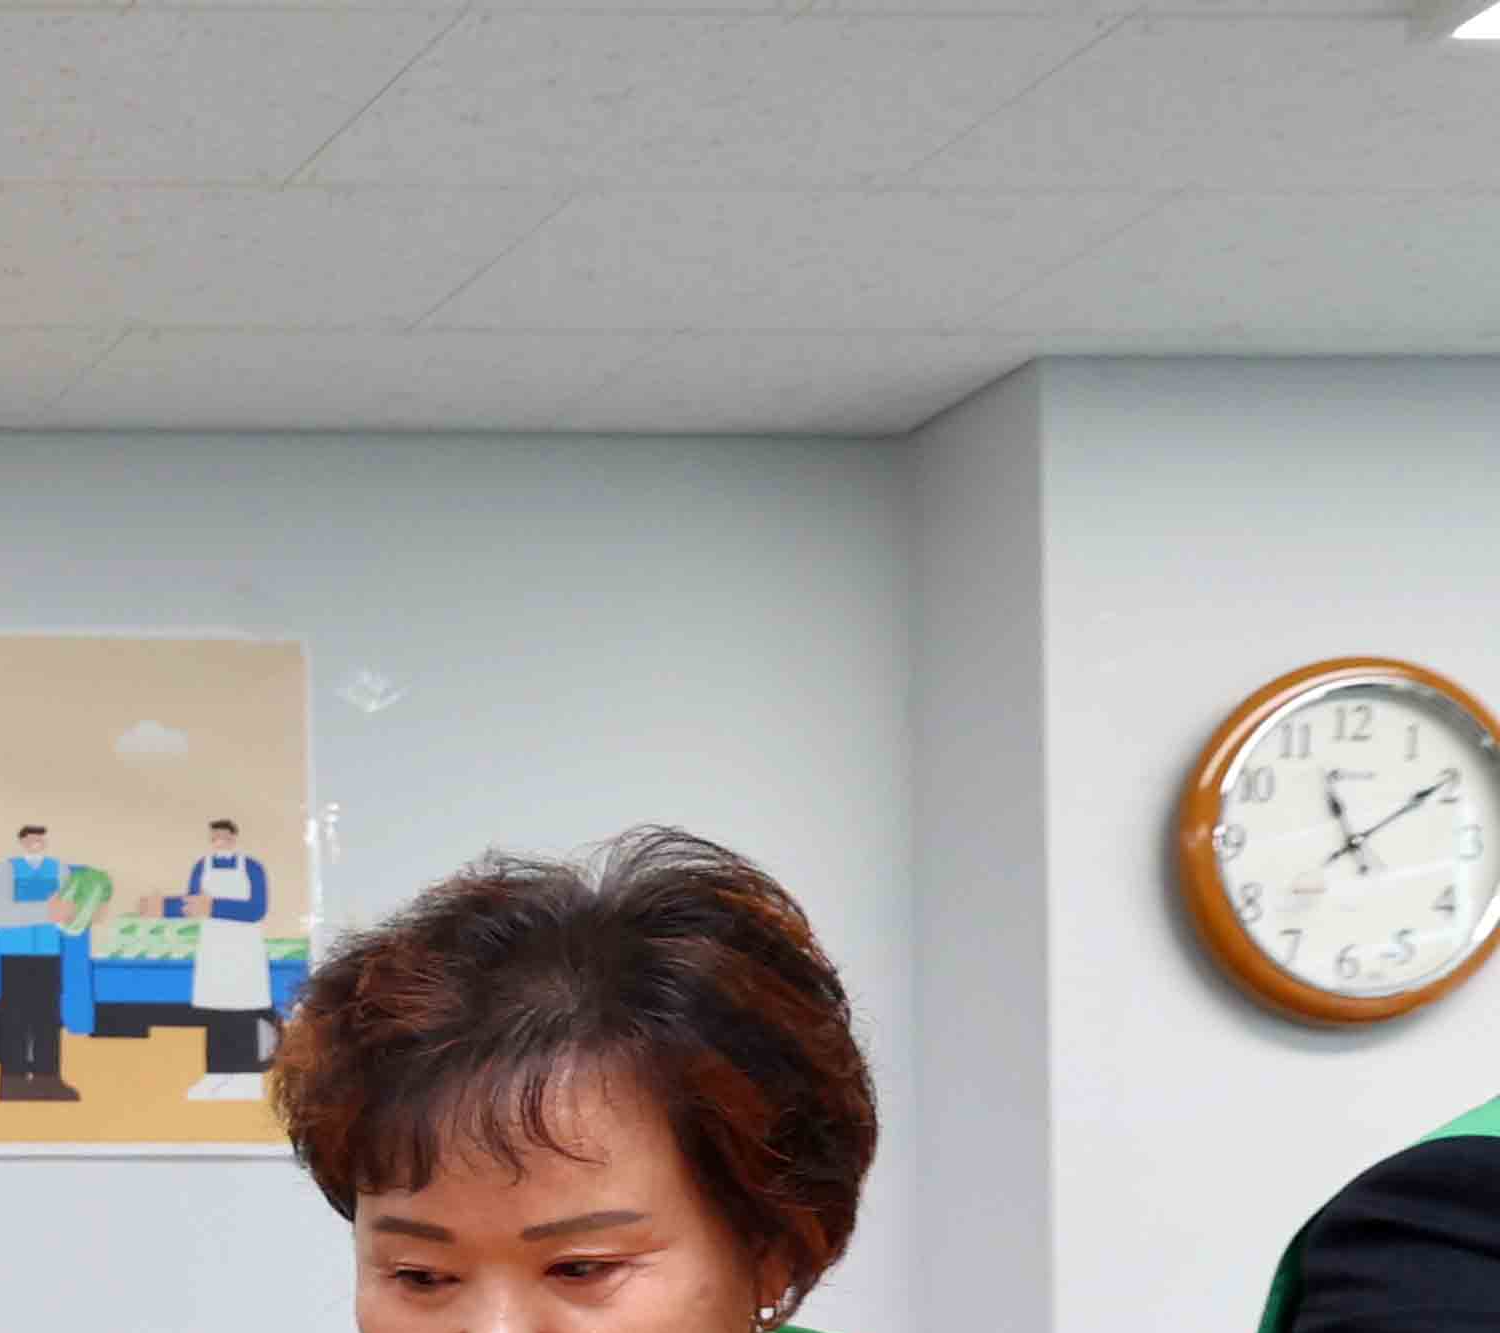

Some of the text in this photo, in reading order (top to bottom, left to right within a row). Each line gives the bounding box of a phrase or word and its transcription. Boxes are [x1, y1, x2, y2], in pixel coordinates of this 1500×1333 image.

[1279, 720, 1312, 760] 11
[1332, 704, 1372, 742] 12
[1404, 722, 1420, 761] 1
[1238, 764, 1275, 803] 10
[1223, 823, 1246, 862] 9
[1456, 823, 1484, 861] 3
[1237, 881, 1264, 922] 8
[1432, 884, 1456, 916] 4
[1279, 928, 1303, 965] 7
[1336, 943, 1361, 980] 6
[1380, 928, 1415, 965] 5
